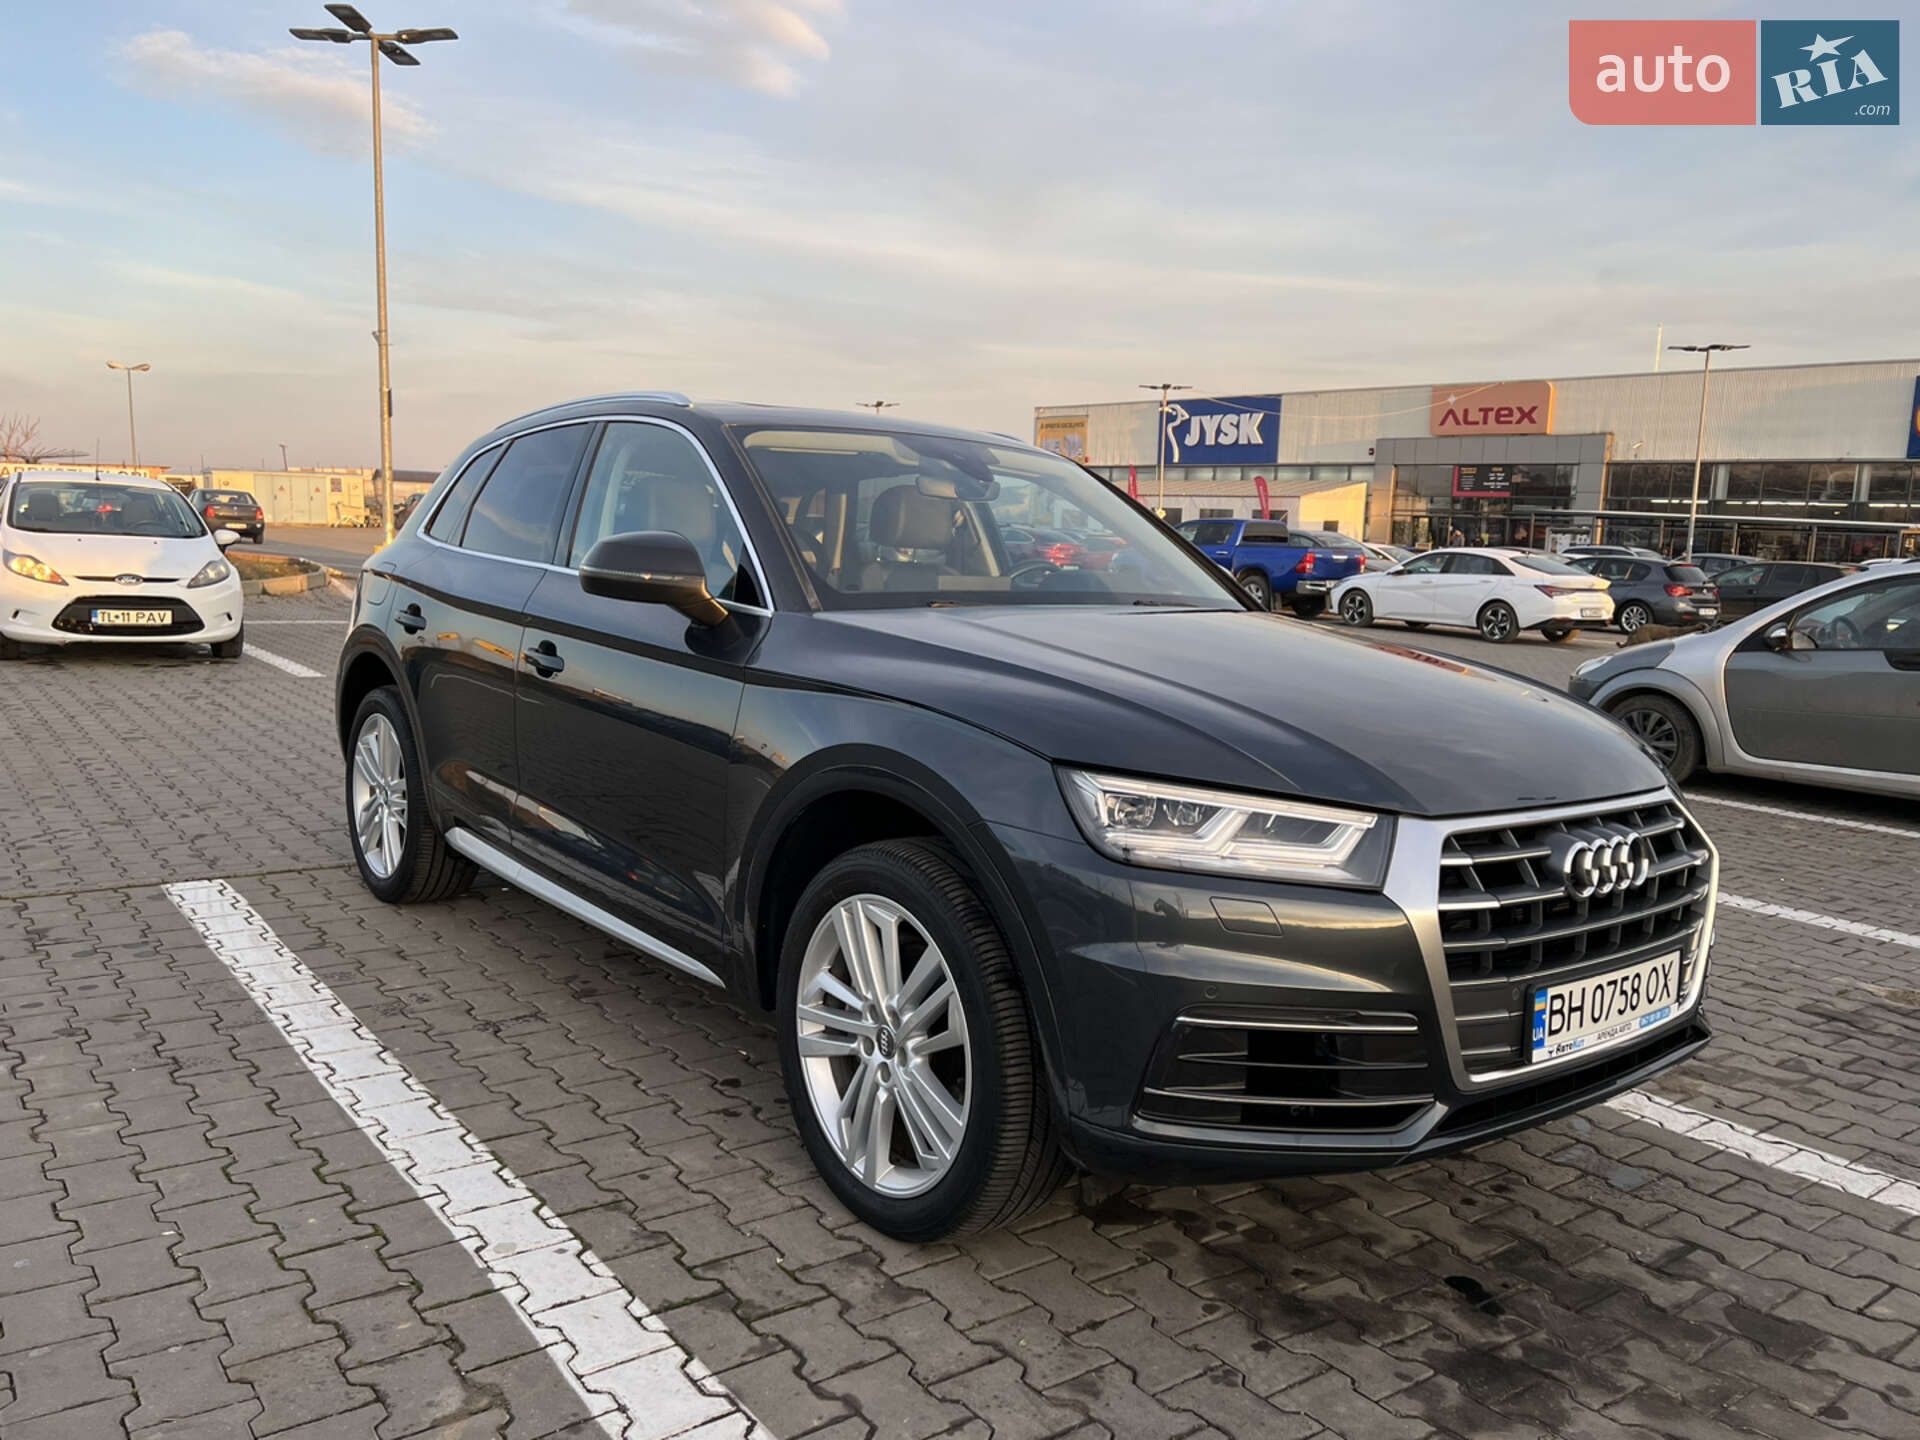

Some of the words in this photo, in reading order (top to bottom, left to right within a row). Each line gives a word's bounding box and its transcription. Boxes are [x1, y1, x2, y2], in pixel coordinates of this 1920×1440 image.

[1184, 412, 1265, 447] JYSK
[99, 611, 115, 623] TL
[135, 611, 167, 623] PAV
[1548, 986, 1587, 1037] BH
[1591, 972, 1641, 1024] 0758
[1646, 960, 1674, 1005] OX
[1532, 1026, 1544, 1041] UA
